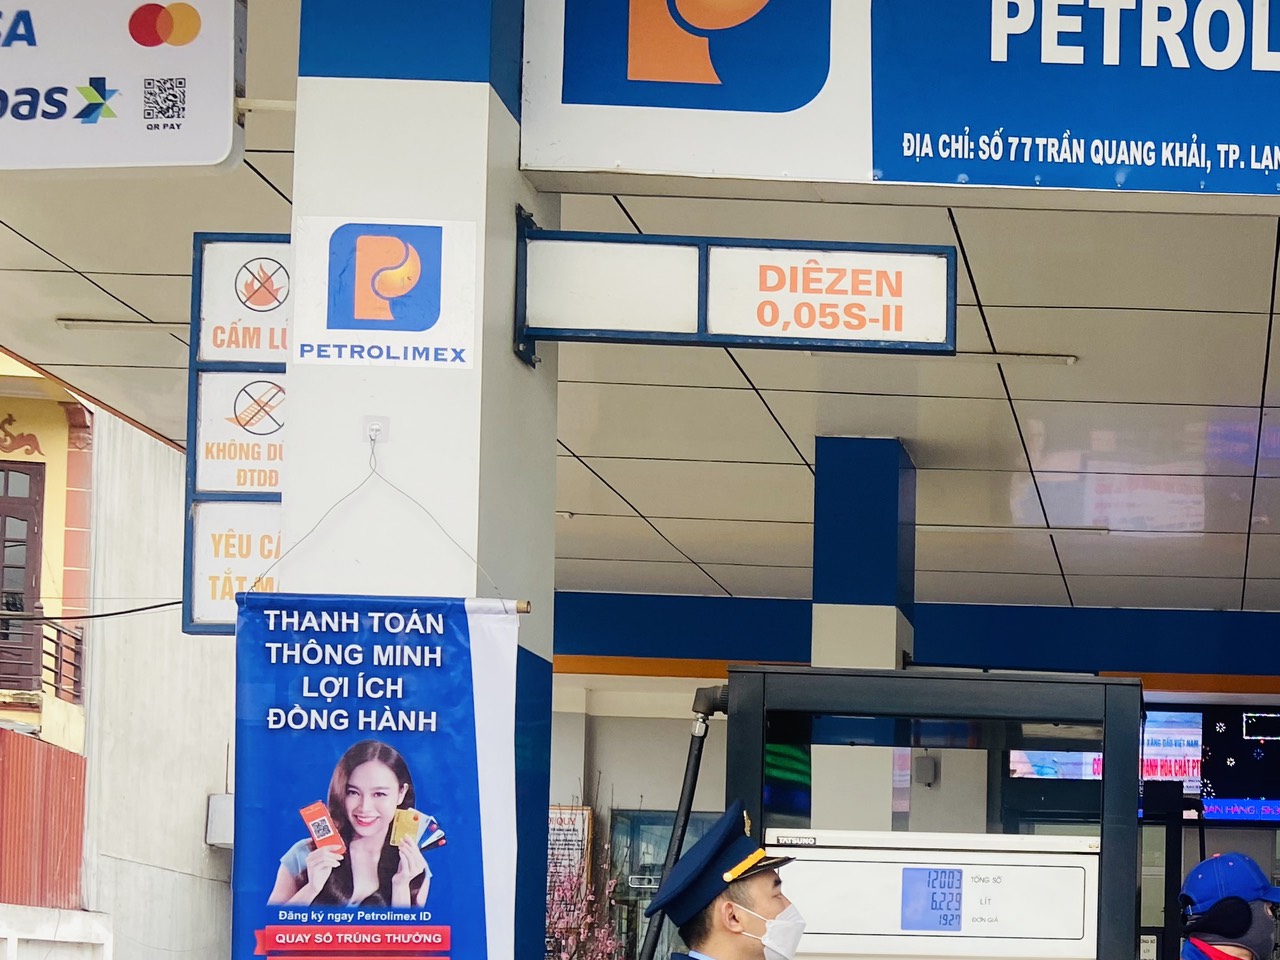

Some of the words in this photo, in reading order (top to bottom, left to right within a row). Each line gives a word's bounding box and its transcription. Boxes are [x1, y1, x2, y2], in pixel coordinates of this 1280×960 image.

[146, 123, 160, 131] QR
[902, 132, 933, 162] ĐỊA
[938, 126, 975, 160] CHỈ:
[978, 127, 1004, 161] SỐ
[1090, 139, 1156, 166] QUANG
[1161, 133, 1212, 174] KHẢI,
[1216, 143, 1245, 169] TP.
[758, 258, 903, 298] DIÊZEN
[756, 299, 904, 332] 0,05S-II
[212, 318, 261, 349] CẤM
[299, 343, 467, 363] PETROLIMEX
[204, 438, 261, 462] KHÔNG
[210, 528, 252, 559] YÊU
[263, 609, 359, 633] THANH
[367, 609, 444, 635] TOÁN
[265, 638, 364, 666] THÔNG
[373, 644, 442, 667] MINH
[302, 676, 349, 703] LỢI
[357, 672, 403, 699] ÍCH
[266, 703, 349, 730] ĐỒNG
[358, 705, 437, 732] HÀNH
[778, 836, 815, 844] TATSUNO
[979, 896, 991, 905] LÍT
[279, 910, 308, 923] Đăng
[311, 910, 325, 923] ký
[327, 912, 354, 923] ngay
[357, 911, 417, 922] Petrolimex
[419, 911, 432, 921] ID
[939, 914, 960, 926] 1927
[275, 933, 312, 944] QUAY
[314, 931, 333, 944] SỐ
[336, 931, 382, 944] TRÚNG
